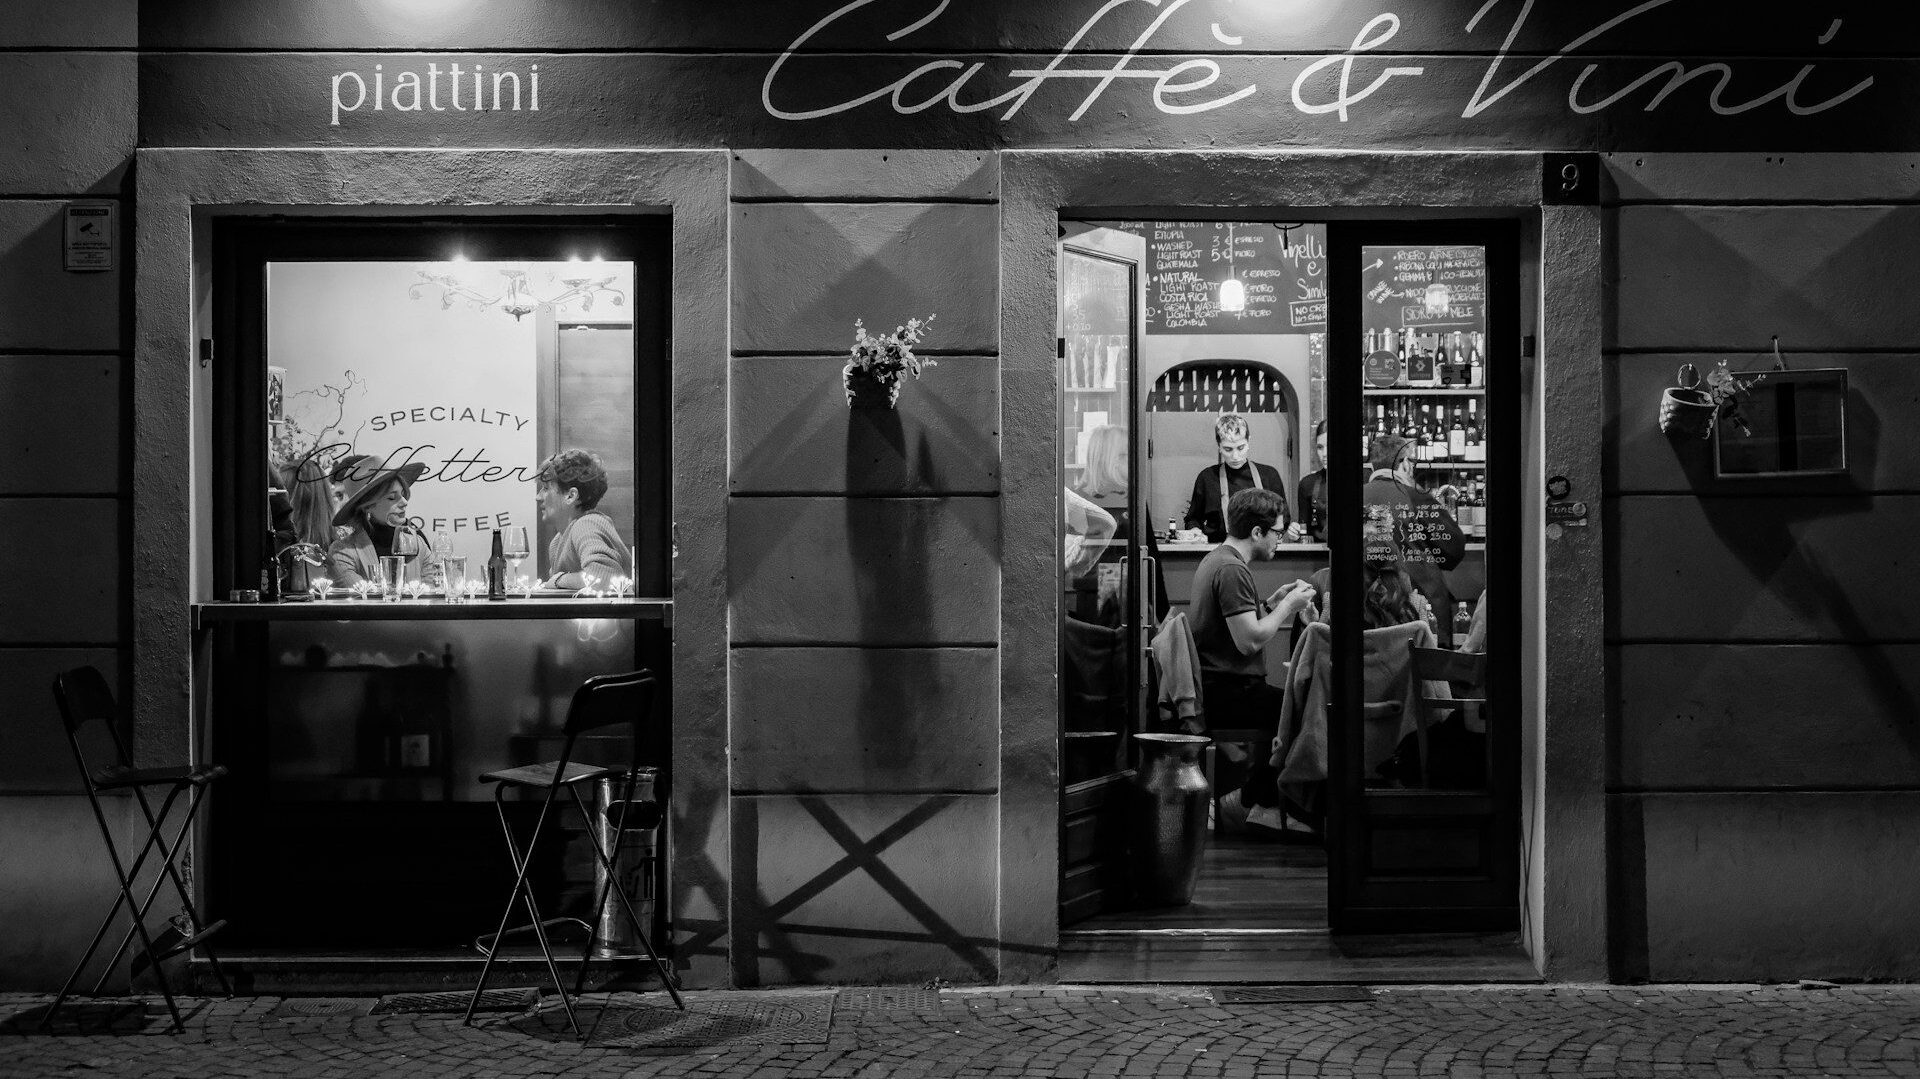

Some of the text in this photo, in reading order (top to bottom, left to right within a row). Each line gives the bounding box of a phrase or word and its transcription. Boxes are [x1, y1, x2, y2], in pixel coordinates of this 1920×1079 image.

[762, 0, 1874, 122] Caffè & Vini
[330, 63, 541, 126] piattini
[1561, 163, 1579, 191] 9
[1211, 248, 1221, 262] 5
[1212, 235, 1221, 248] 3
[1160, 271, 1204, 284] NATURAL
[371, 405, 530, 432] SPECIALTY
